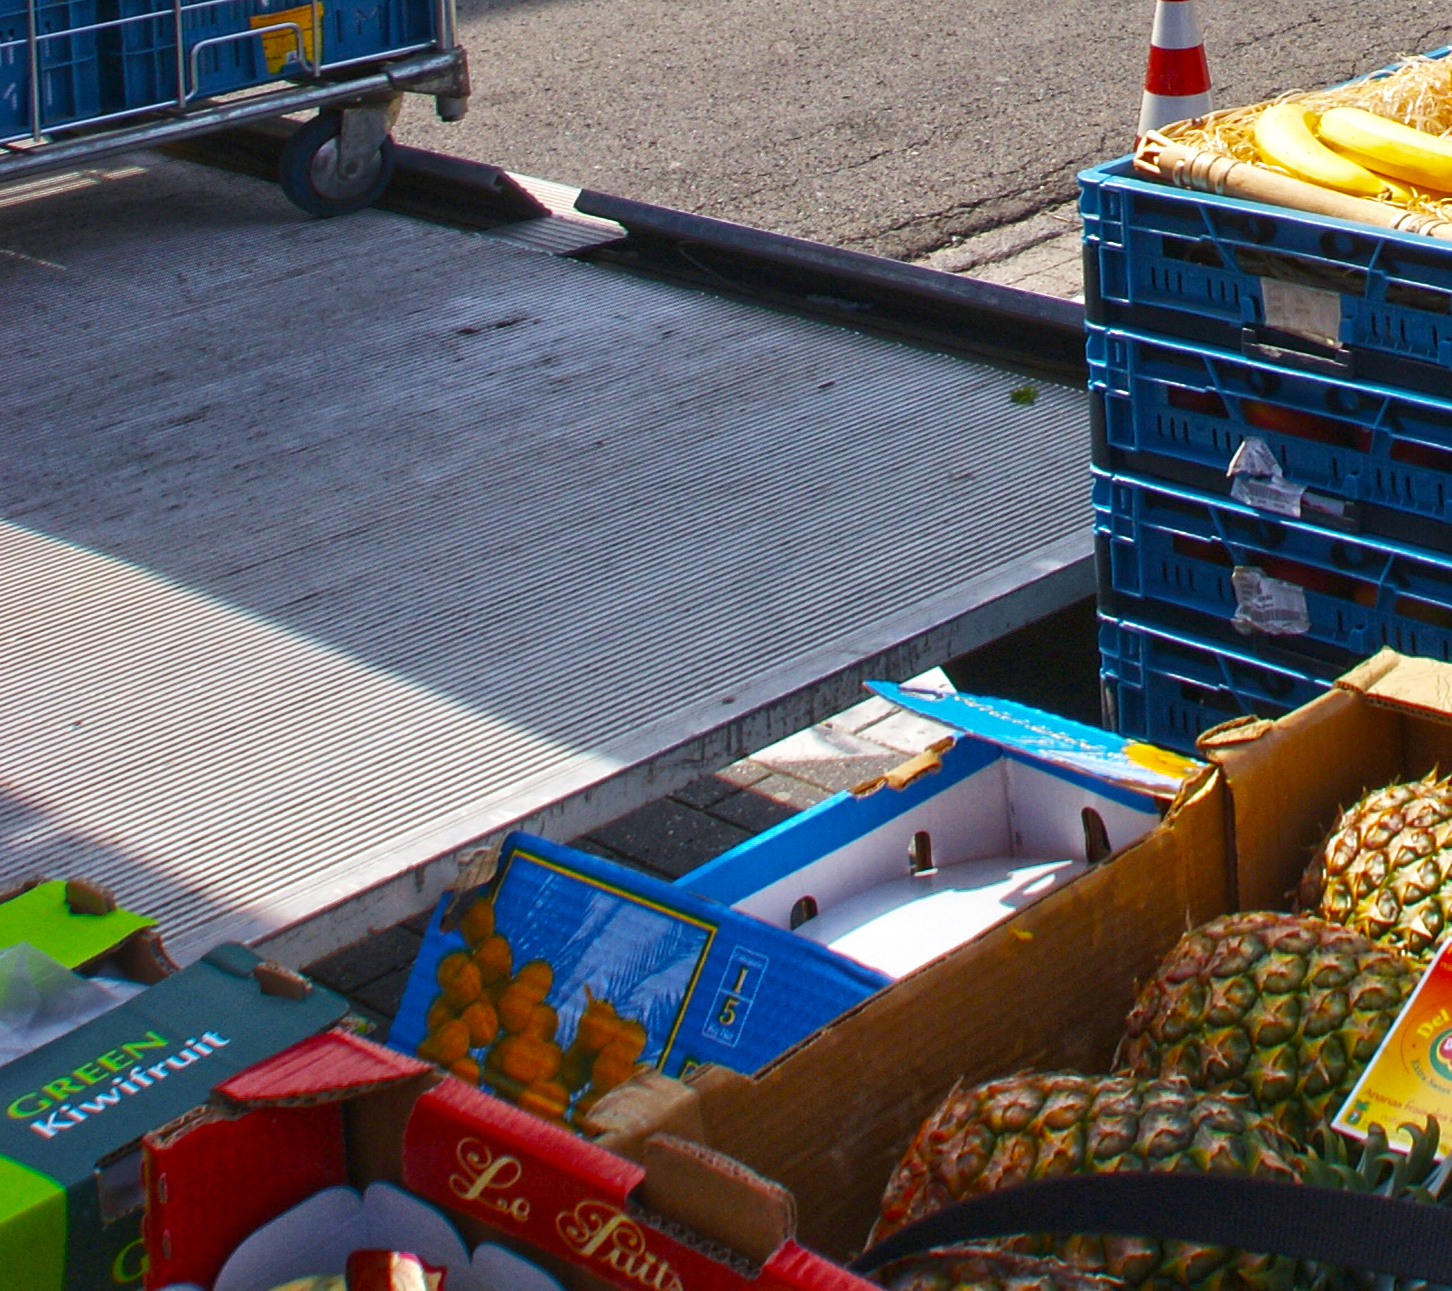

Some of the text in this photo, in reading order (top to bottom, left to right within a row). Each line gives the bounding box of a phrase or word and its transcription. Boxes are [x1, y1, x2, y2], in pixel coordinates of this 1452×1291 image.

[718, 998, 740, 1026] 5
[1416, 1008, 1451, 1041] Del
[7, 1029, 169, 1119] GREEN
[29, 1029, 231, 1140] Kiwifruit
